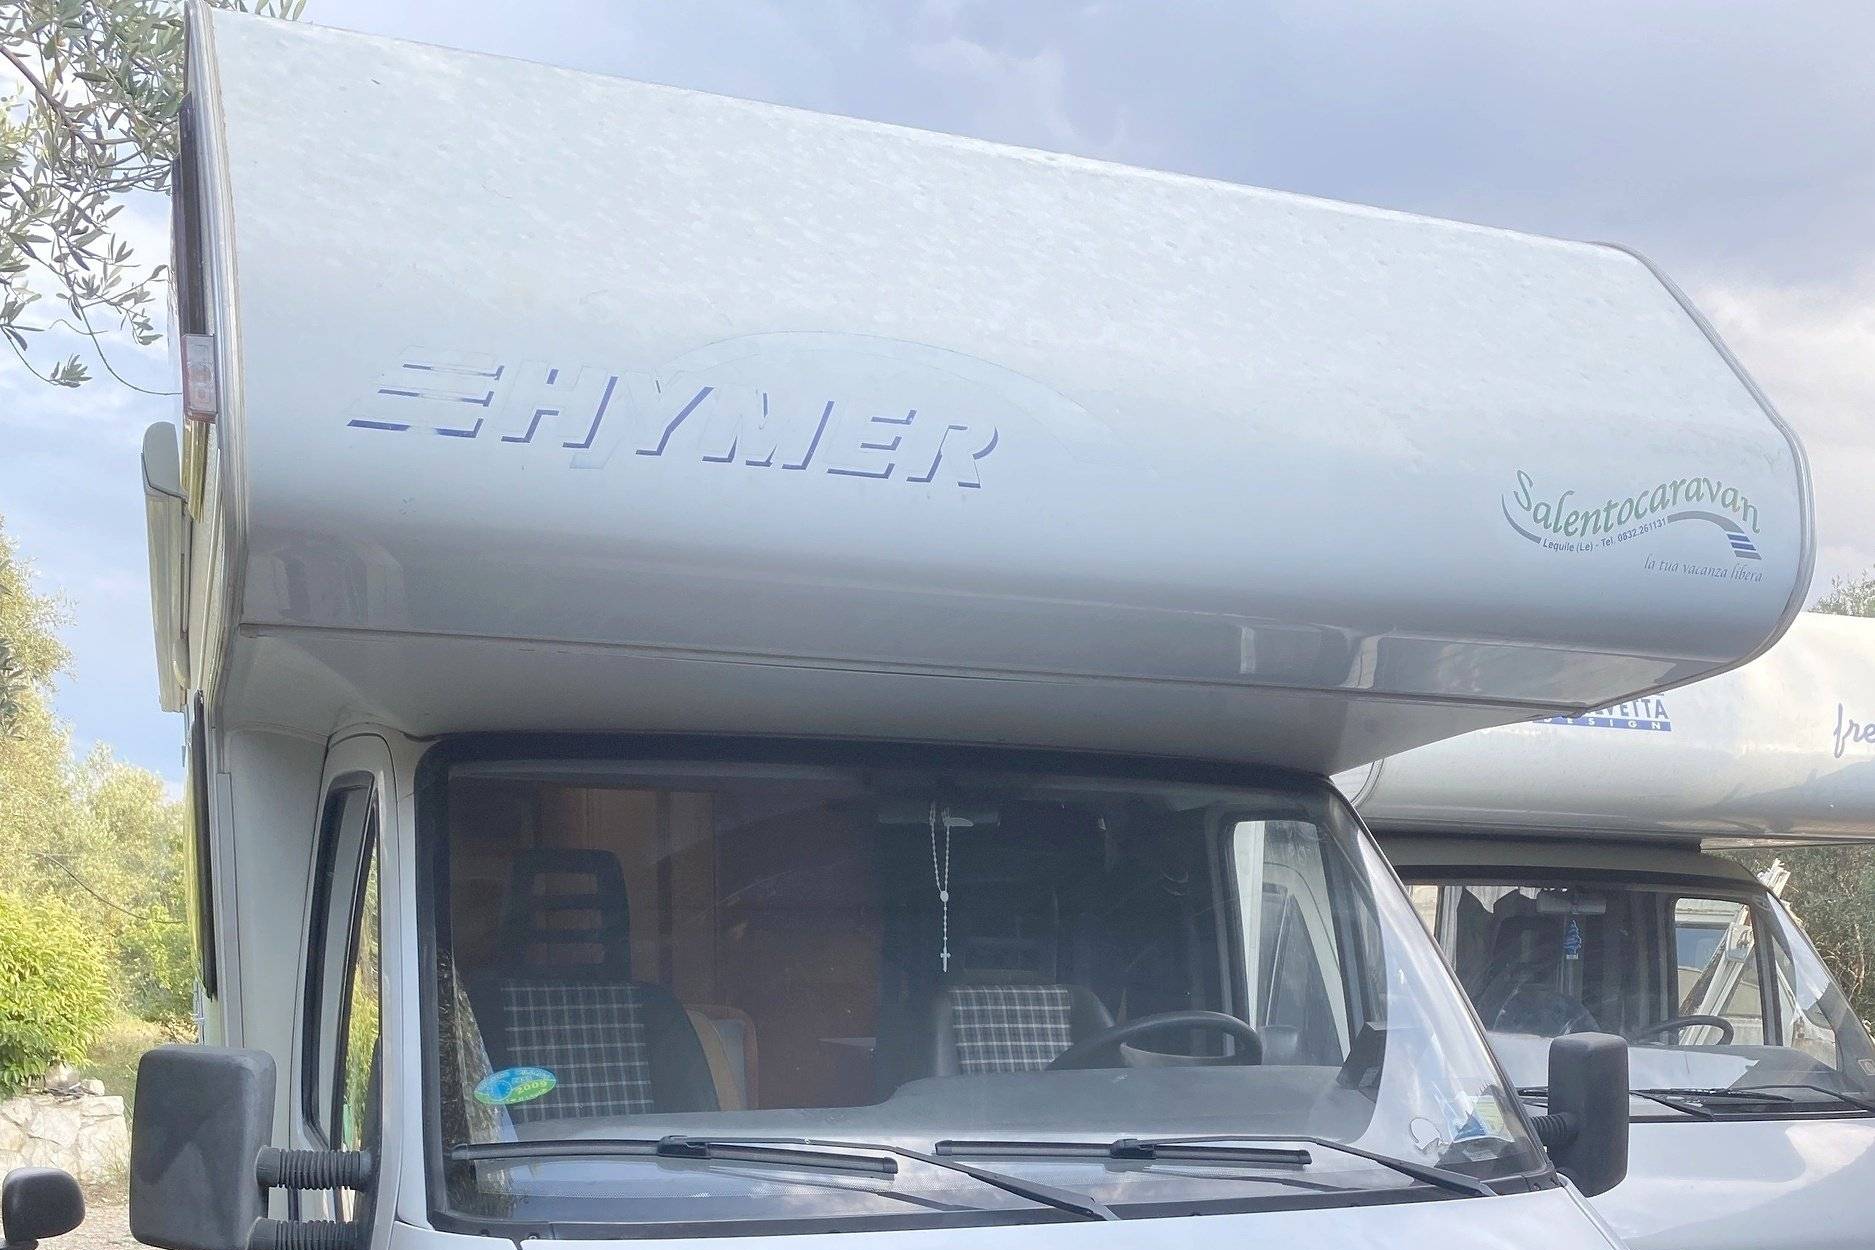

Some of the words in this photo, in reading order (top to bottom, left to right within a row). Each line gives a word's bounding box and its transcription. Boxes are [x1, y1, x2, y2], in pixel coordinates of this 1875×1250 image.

[498, 359, 1000, 490] HYMER
[1512, 469, 1761, 534] Salentocaravan
[1543, 537, 1575, 553] Lequile
[1576, 540, 1594, 553] (Le)
[1644, 554, 1656, 570] la
[1659, 559, 1679, 573] tua
[1683, 563, 1728, 579] vacanza
[1730, 561, 1764, 582] libera
